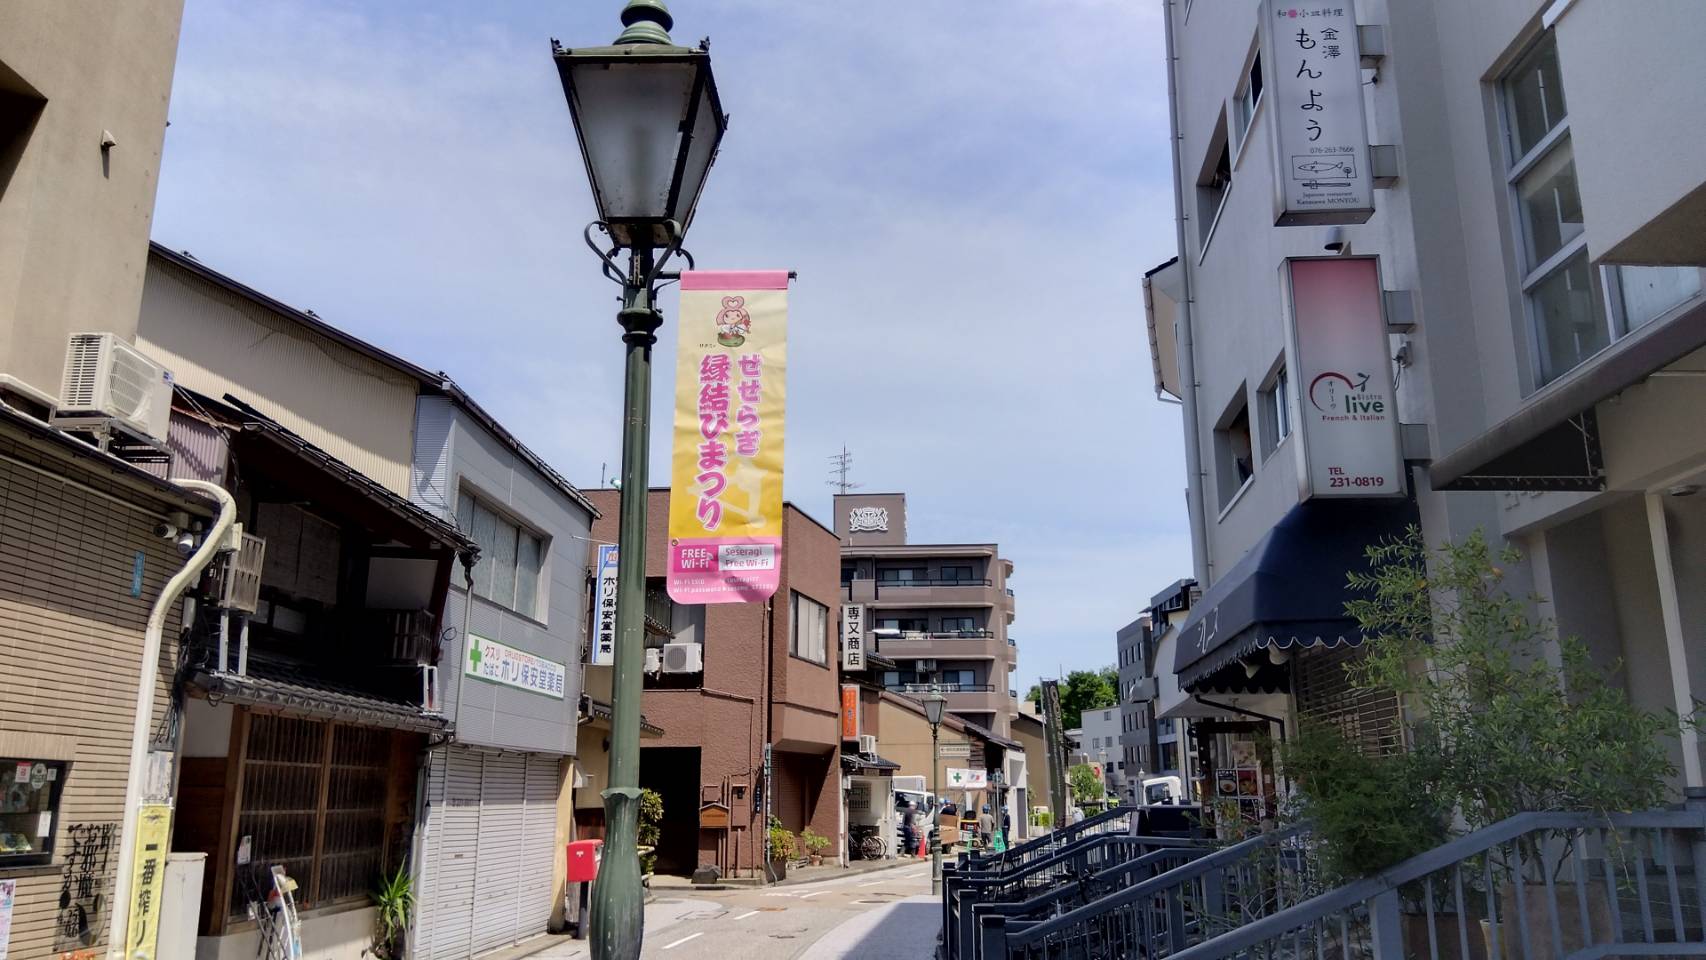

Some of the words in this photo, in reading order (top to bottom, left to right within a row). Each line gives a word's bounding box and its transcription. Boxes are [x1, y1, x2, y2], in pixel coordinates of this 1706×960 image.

[1320, 27, 1341, 59] 金澤
[1296, 27, 1323, 141] もんよう
[736, 353, 762, 458] せせらぎ
[697, 353, 729, 532] 縁結びまつり
[1328, 467, 1345, 475] TEL
[1329, 476, 1385, 488] 231-0819
[681, 548, 707, 559] FREE
[681, 558, 709, 569] Wi-Fi
[725, 546, 763, 557] Seseragi
[725, 559, 746, 567] Free
[746, 558, 769, 567] Wi-Fi
[600, 576, 616, 654] ホリ保安堂薬局
[847, 606, 860, 666] 専又商店
[501, 660, 563, 694] ホリ保安堂薬局
[136, 843, 159, 948] 一番搾り
